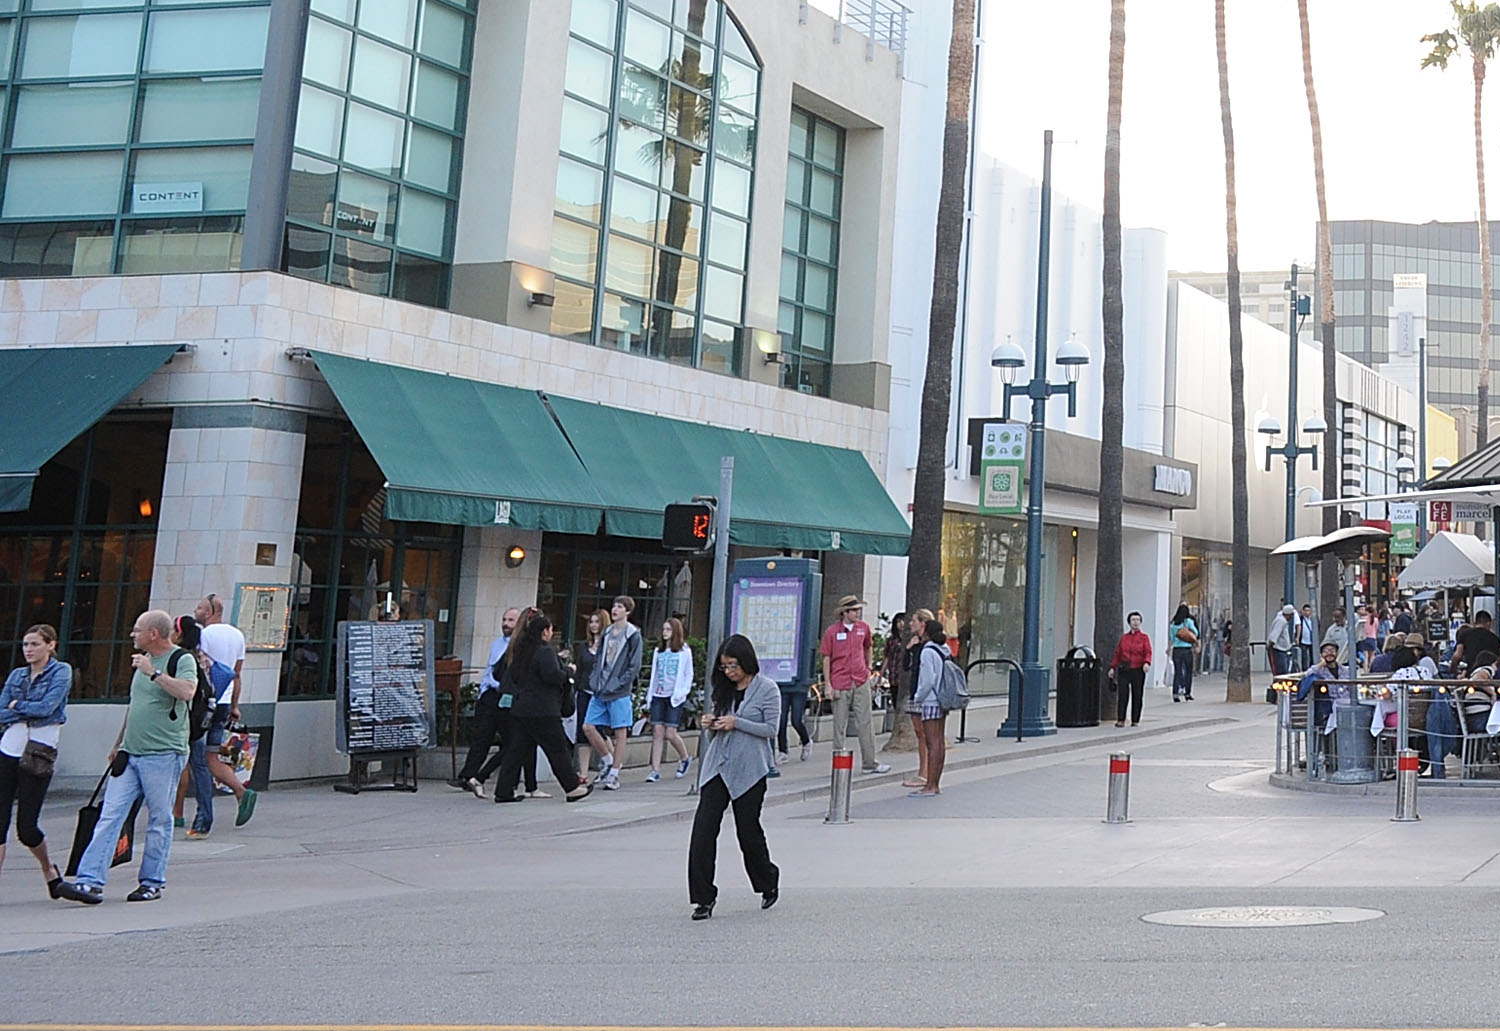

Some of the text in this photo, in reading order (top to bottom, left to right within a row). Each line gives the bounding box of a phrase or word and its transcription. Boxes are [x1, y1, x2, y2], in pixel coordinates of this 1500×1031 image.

[139, 191, 199, 202] CONTENT
[1432, 502, 1448, 510] CA
[1433, 511, 1447, 520] FE
[1456, 508, 1492, 518] marcel
